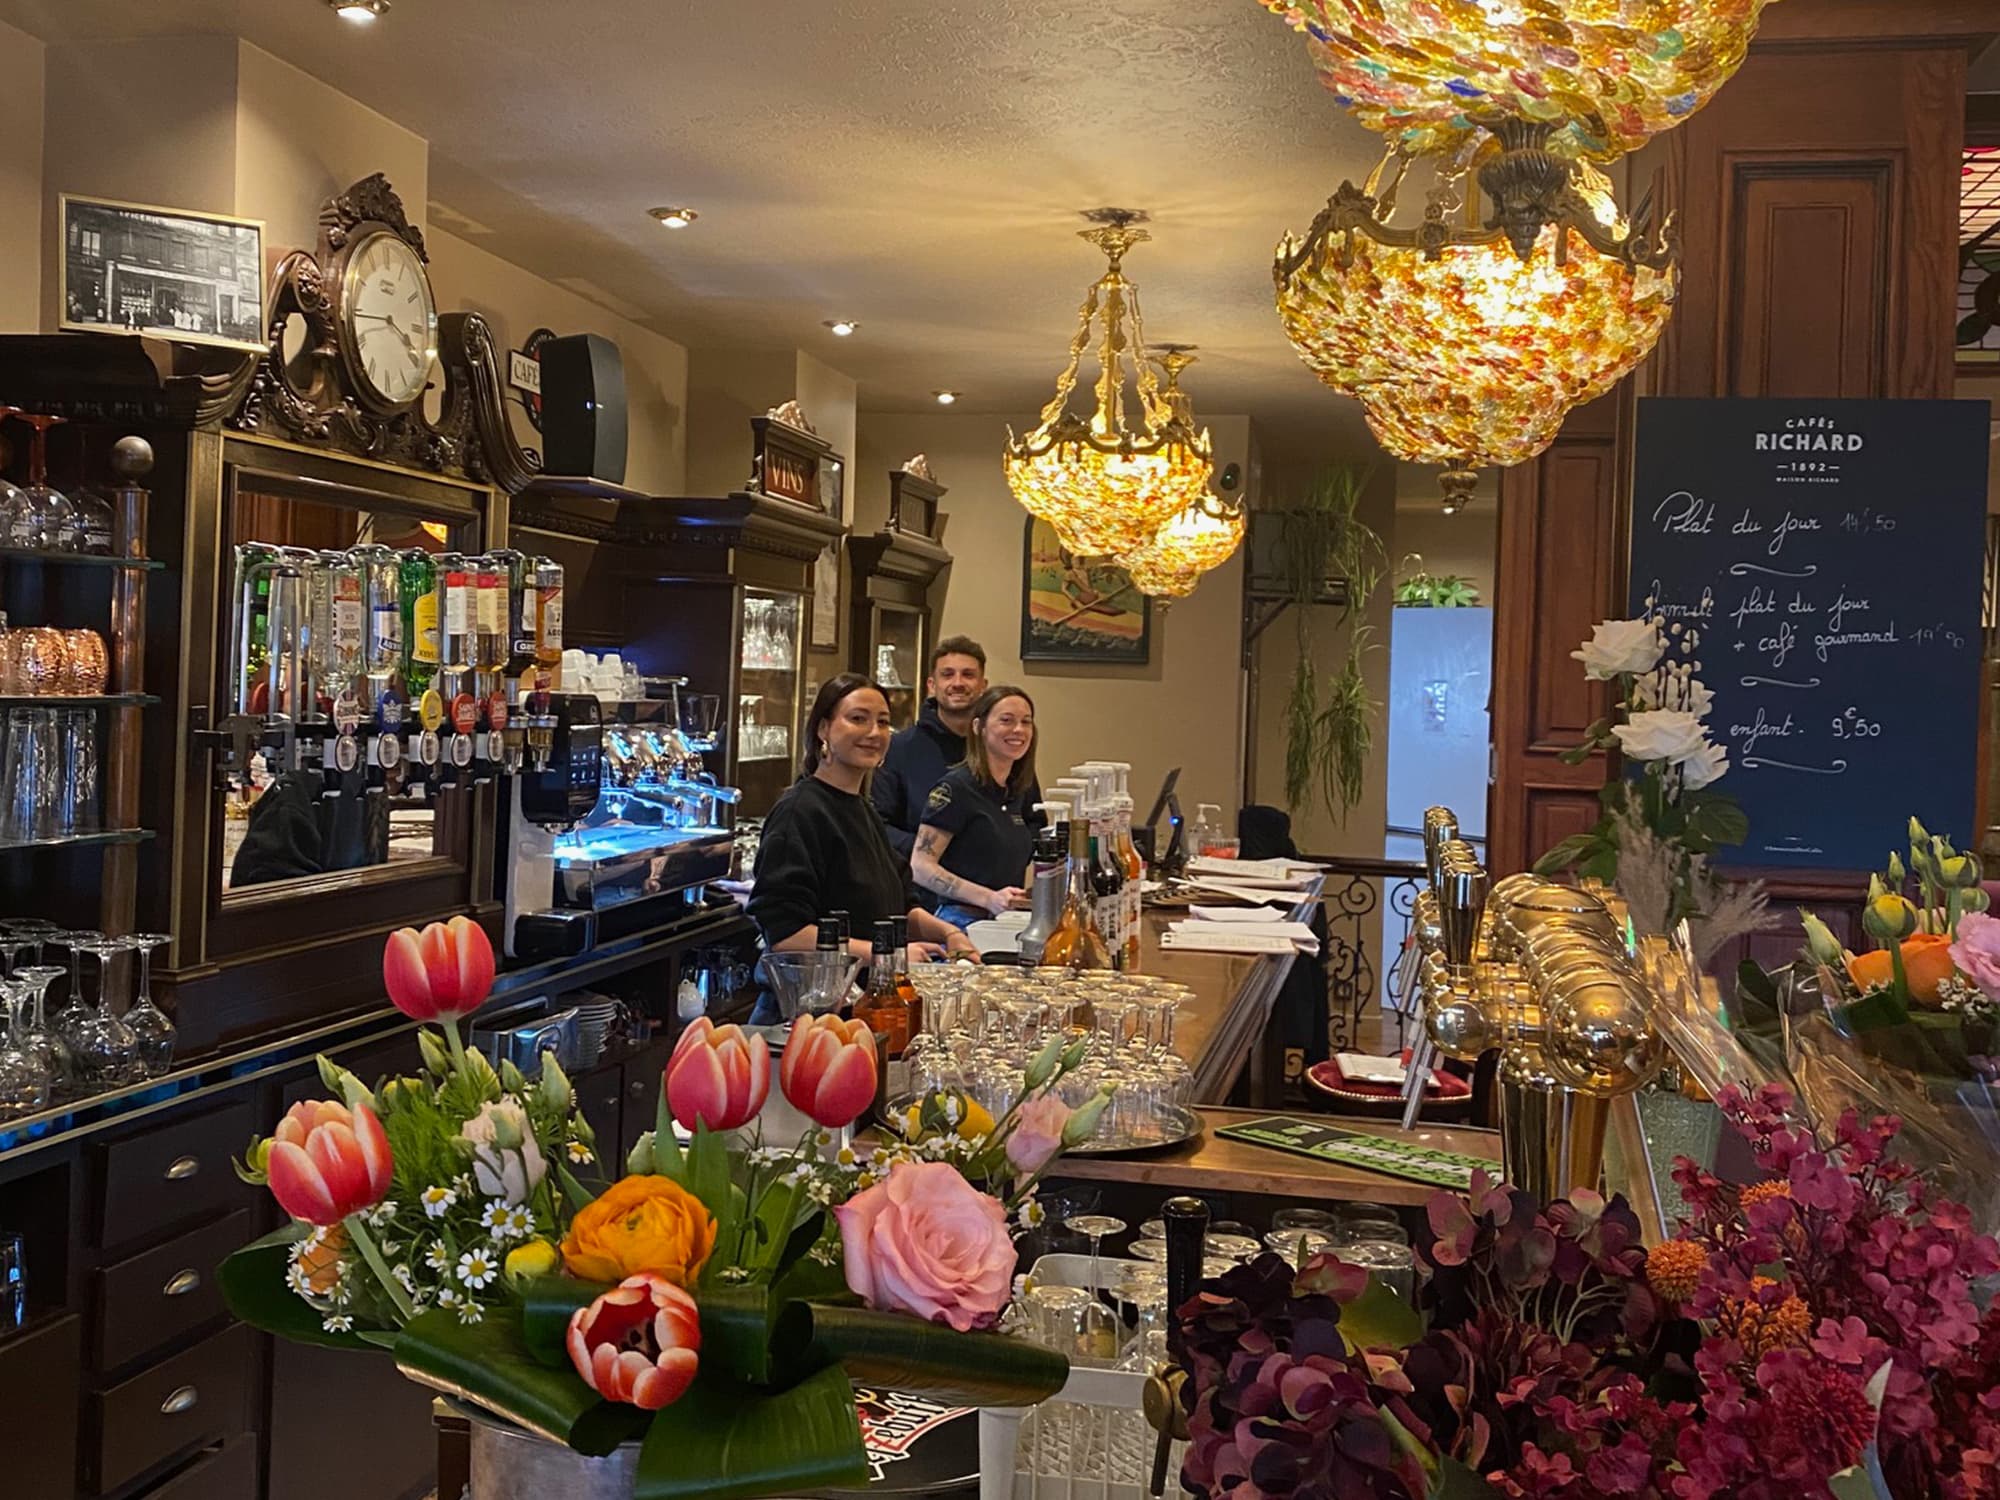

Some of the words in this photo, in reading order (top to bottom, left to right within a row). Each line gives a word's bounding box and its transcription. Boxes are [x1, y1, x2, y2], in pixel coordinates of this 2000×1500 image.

[1755, 433, 1863, 452] RICHARD
[1786, 417, 1835, 430] CAFÉS
[771, 454, 804, 494] VINS
[1791, 462, 1827, 472] 1892
[1652, 491, 1716, 533] Plat
[1732, 508, 1763, 534] du
[1768, 511, 1822, 555] jour
[1730, 586, 1776, 629] plat
[1788, 591, 1816, 613] du
[1827, 584, 1871, 631] jour
[1758, 621, 1799, 668] café
[1815, 619, 1900, 662] gourmand
[1730, 707, 1794, 754] enfant
